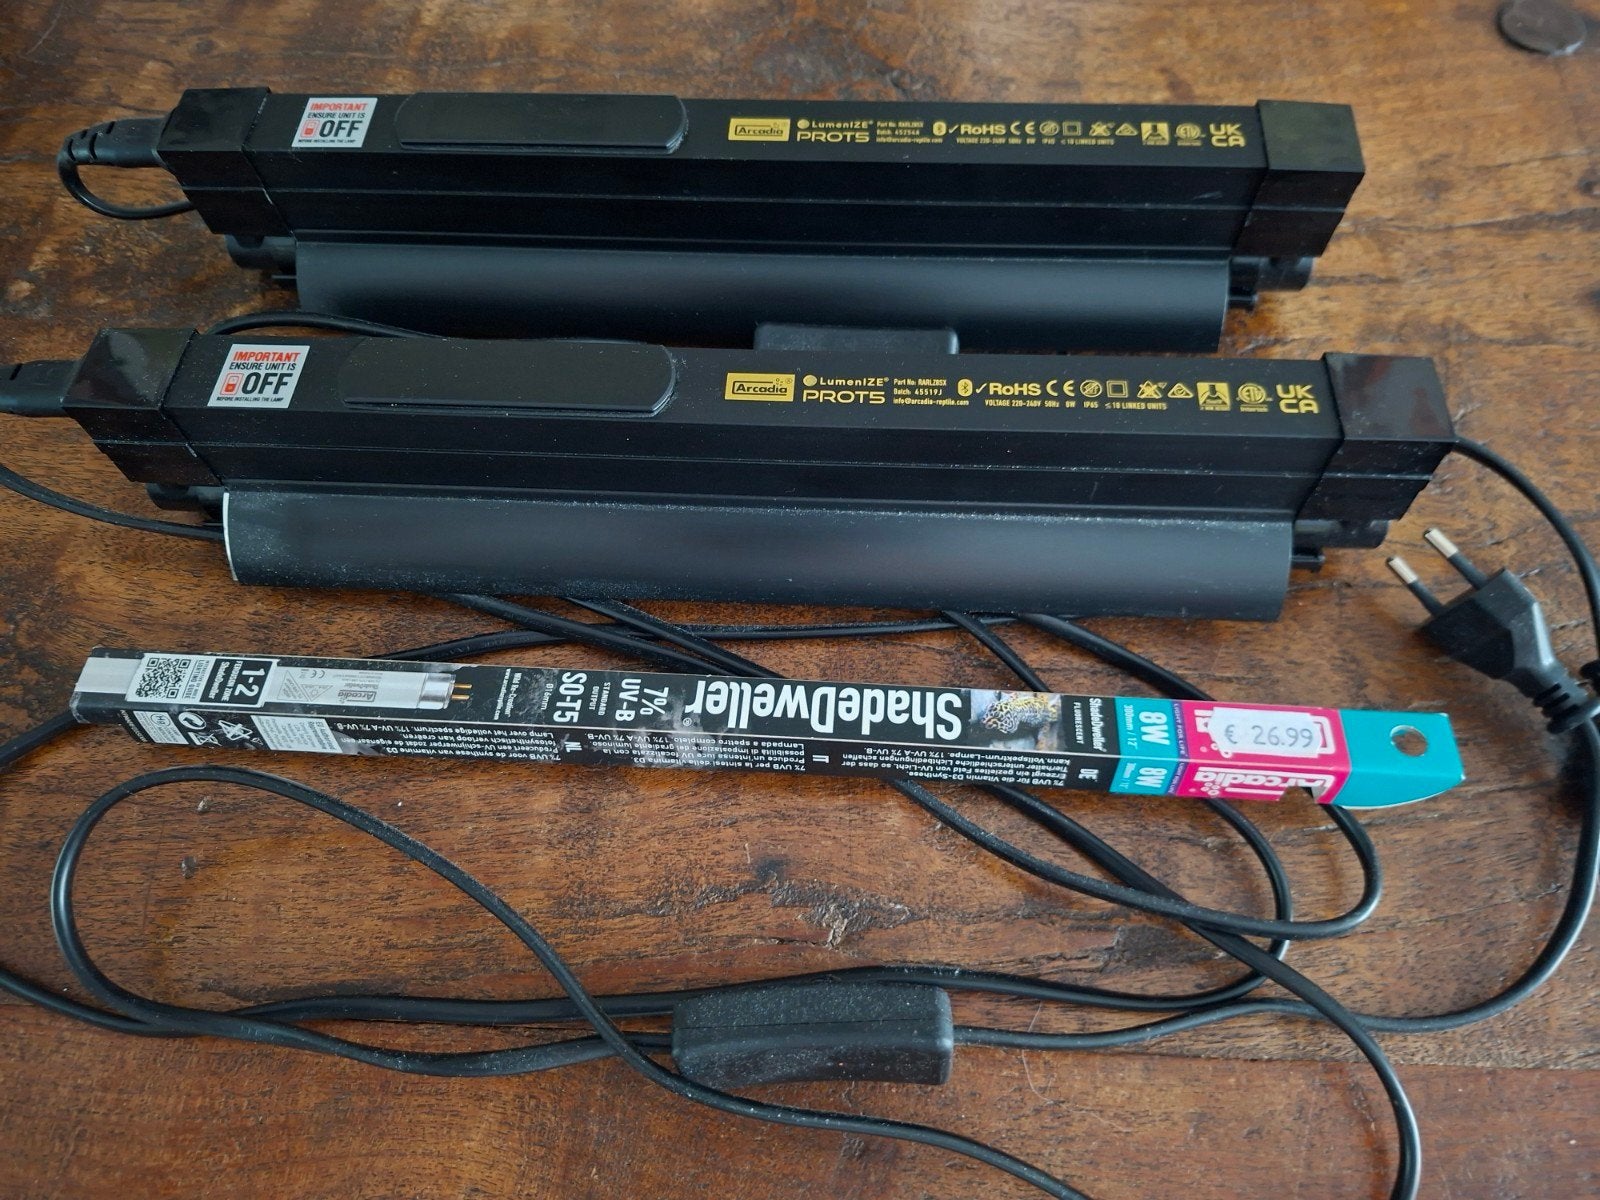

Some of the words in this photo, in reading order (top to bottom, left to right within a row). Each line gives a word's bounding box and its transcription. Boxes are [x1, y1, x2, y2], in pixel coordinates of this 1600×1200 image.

[310, 102, 368, 111] IMPORTANT
[319, 120, 363, 137] OFF
[961, 124, 1006, 135] RoHS
[1010, 122, 1035, 135] CE
[1210, 123, 1242, 135] UK
[1211, 135, 1245, 147] CA
[234, 351, 300, 362] IMPORTANT
[229, 362, 263, 370] ENSURE
[242, 372, 293, 394] OFF
[736, 383, 787, 393] Arcadia
[989, 382, 1041, 396] RoHS
[1046, 380, 1075, 396] CE
[803, 389, 885, 404] PROT5
[1276, 384, 1315, 398] UK
[893, 398, 969, 406] info@arcadia-reptile.com
[1279, 399, 1319, 414] CA
[234, 668, 266, 696] 1-2
[338, 691, 373, 700] Arcadia
[553, 672, 587, 723] SO-T5
[589, 686, 599, 710] OUTPUT
[598, 682, 611, 716] STANDARD
[615, 679, 641, 721] UV-B
[640, 687, 669, 715] 7%
[1124, 705, 1134, 731] 300mm
[1139, 711, 1170, 745] 8W
[490, 738, 556, 746] fotosynthetisch
[1225, 724, 1237, 745] €
[1250, 724, 1314, 748] 26.99
[429, 742, 496, 750] UV-schijnwerper
[564, 742, 582, 752] NL
[692, 746, 748, 754] impostazione
[761, 741, 804, 749] Lampada
[812, 755, 829, 763] IT
[880, 755, 953, 765] Lichtbedingungen
[955, 760, 1024, 769] unterschiedliche
[1026, 764, 1068, 772] Tierhalter
[1078, 768, 1099, 780] DE
[1032, 771, 1066, 779] Erzeugt
[1134, 767, 1168, 788] 8W
